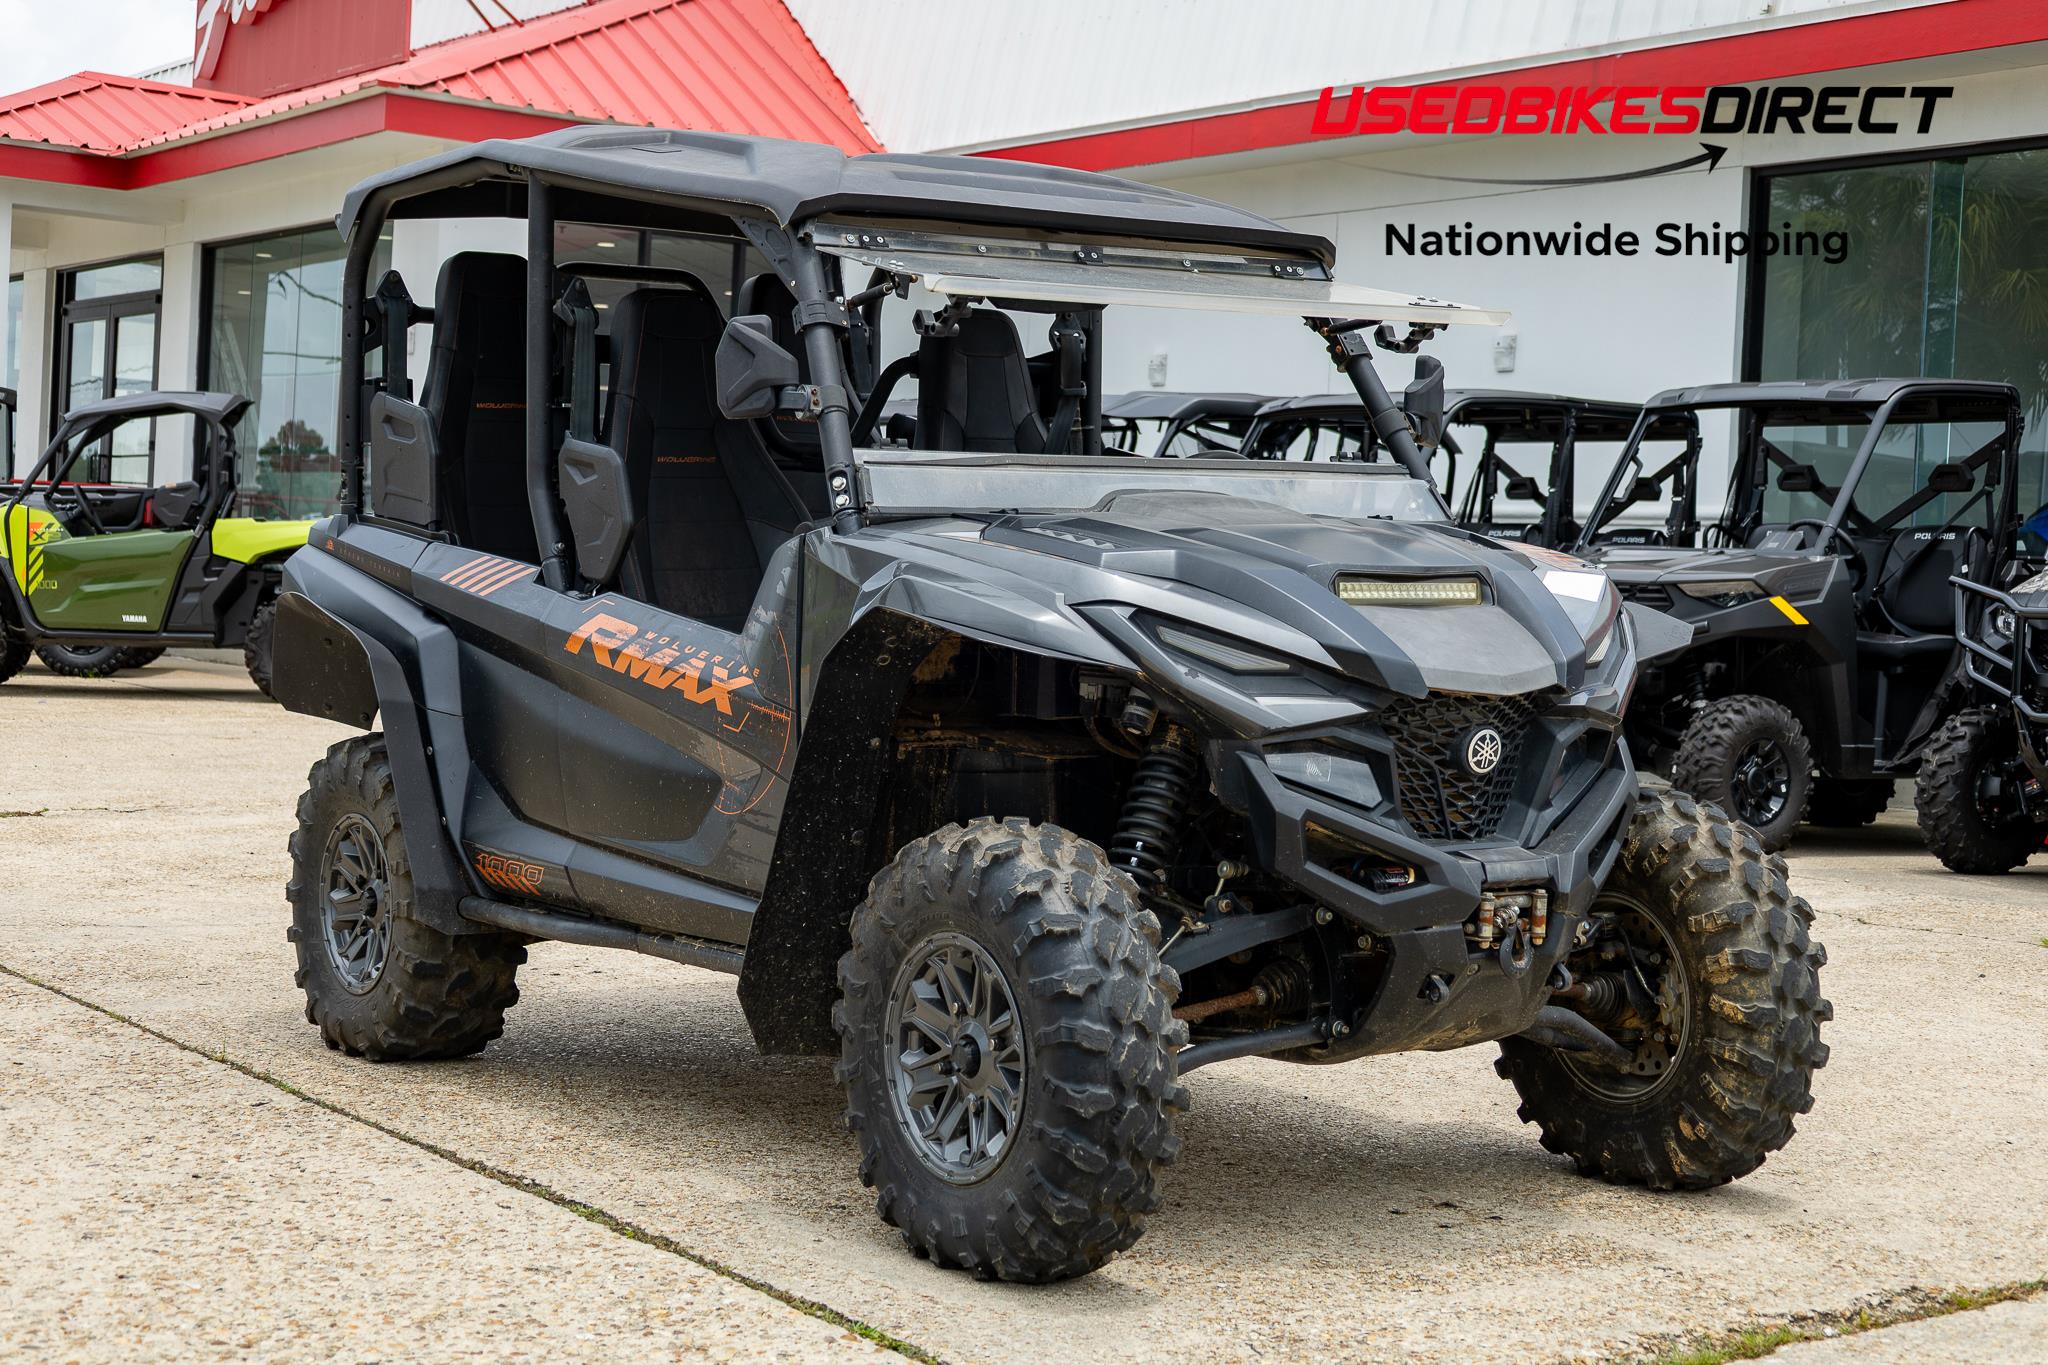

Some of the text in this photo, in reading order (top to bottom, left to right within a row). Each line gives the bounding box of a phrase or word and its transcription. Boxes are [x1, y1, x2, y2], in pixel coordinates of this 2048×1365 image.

[1914, 532, 1956, 540] POLRIS
[121, 614, 148, 623] YAMAHA
[564, 612, 754, 716] RMAX
[644, 630, 761, 678] WOLVERINE
[476, 853, 545, 885] 1000
